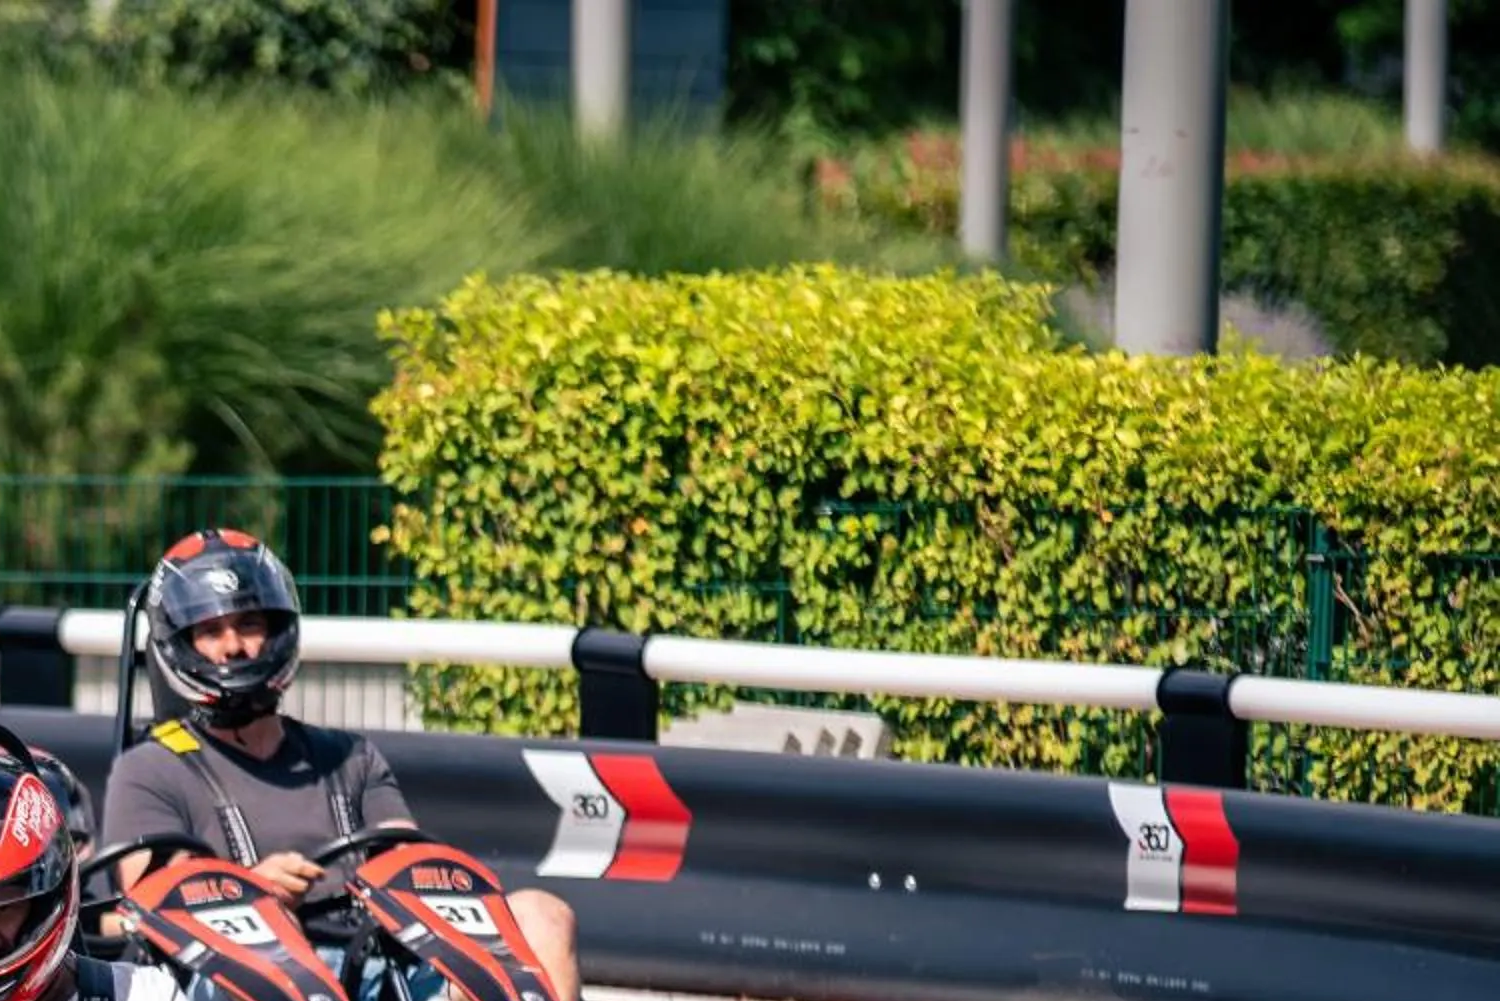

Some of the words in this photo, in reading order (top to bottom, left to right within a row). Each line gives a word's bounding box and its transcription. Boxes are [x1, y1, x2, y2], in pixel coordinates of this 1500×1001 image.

[572, 794, 609, 819] 360
[1138, 824, 1169, 851] 360
[210, 915, 259, 934] 37
[435, 904, 484, 923] 37
